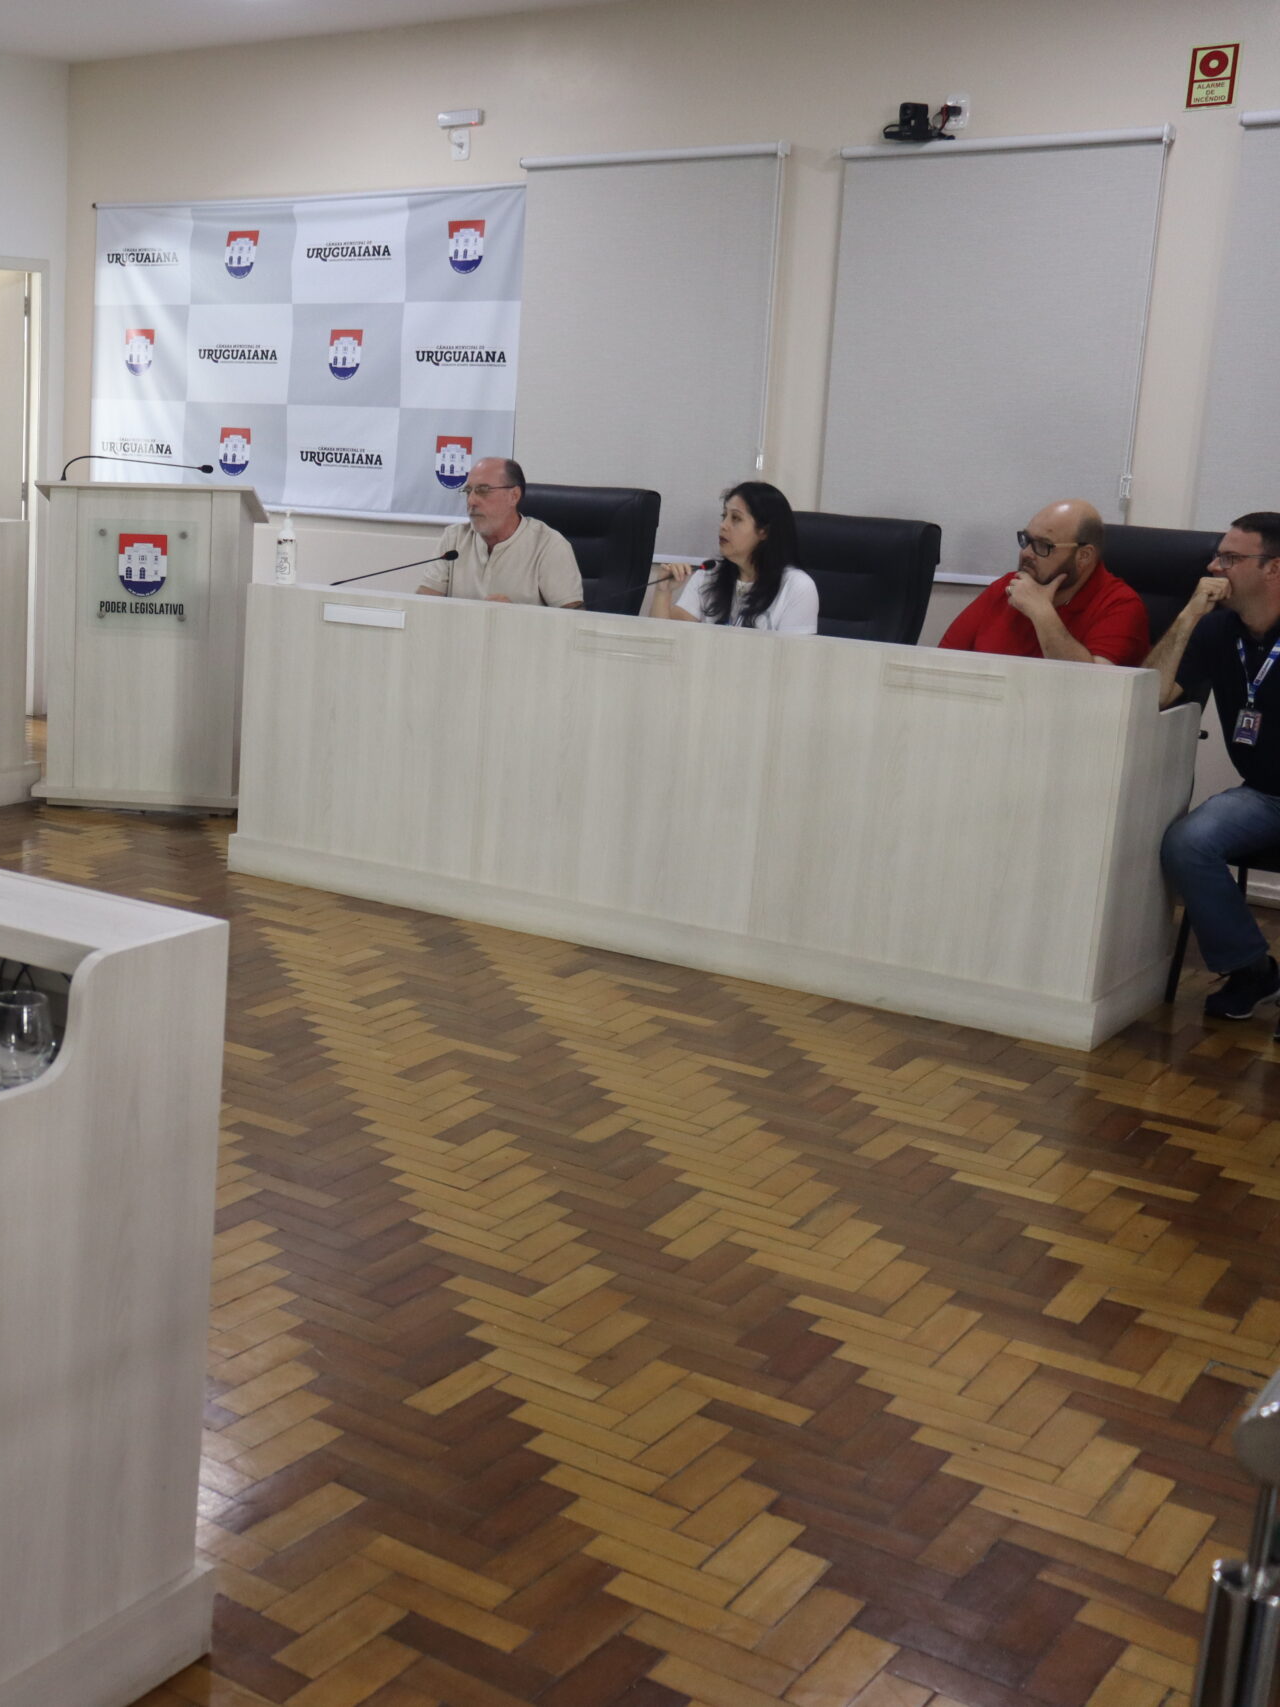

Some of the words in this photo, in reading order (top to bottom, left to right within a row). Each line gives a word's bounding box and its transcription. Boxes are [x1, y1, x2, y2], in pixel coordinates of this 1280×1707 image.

[1197, 82, 1225, 90] ALARME
[107, 252, 179, 267] URUGUAIANA
[306, 245, 391, 262] URUGUAIANA
[198, 348, 277, 364] URUGUAIANA
[416, 350, 506, 366] URUGUAIANA
[101, 441, 172, 456] URUGUAIANA
[300, 450, 383, 467] URUGUAIANA
[100, 601, 127, 614] PODER
[129, 602, 184, 615] LEGISLATIVO
